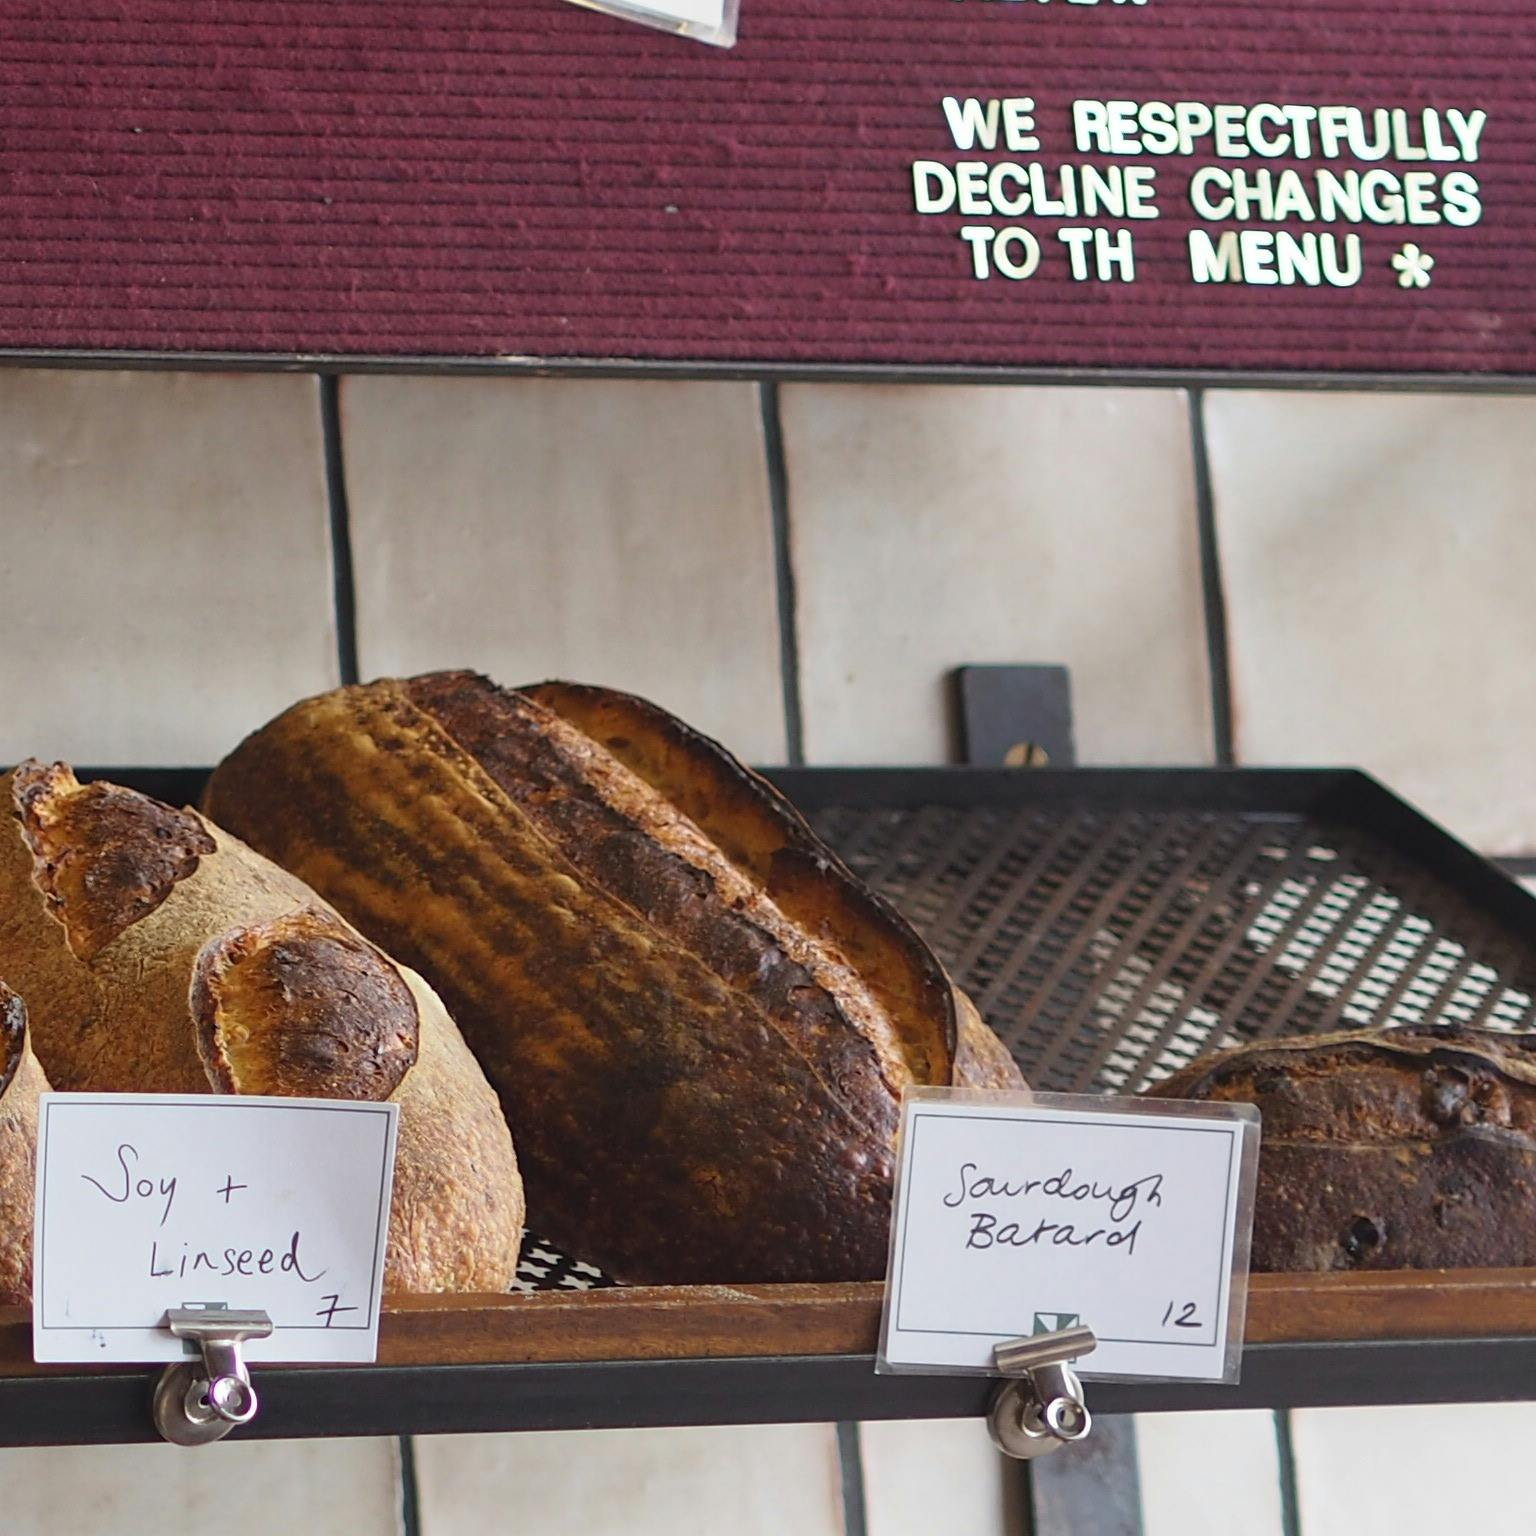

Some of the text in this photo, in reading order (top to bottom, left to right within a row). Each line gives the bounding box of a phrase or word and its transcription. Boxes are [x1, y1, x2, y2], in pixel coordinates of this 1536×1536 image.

[943, 97, 1486, 162] WE RESPECTFULLY
[913, 161, 1481, 226] DECLINE CHANGES
[961, 226, 1361, 286] TO TH MENU
[81, 1143, 248, 1227] Soy +
[943, 1163, 1164, 1222] Sourdough
[149, 1231, 327, 1283] Linseed
[965, 1213, 1143, 1255] Batard
[316, 1294, 359, 1328] 7
[1161, 1300, 1203, 1328] 12
